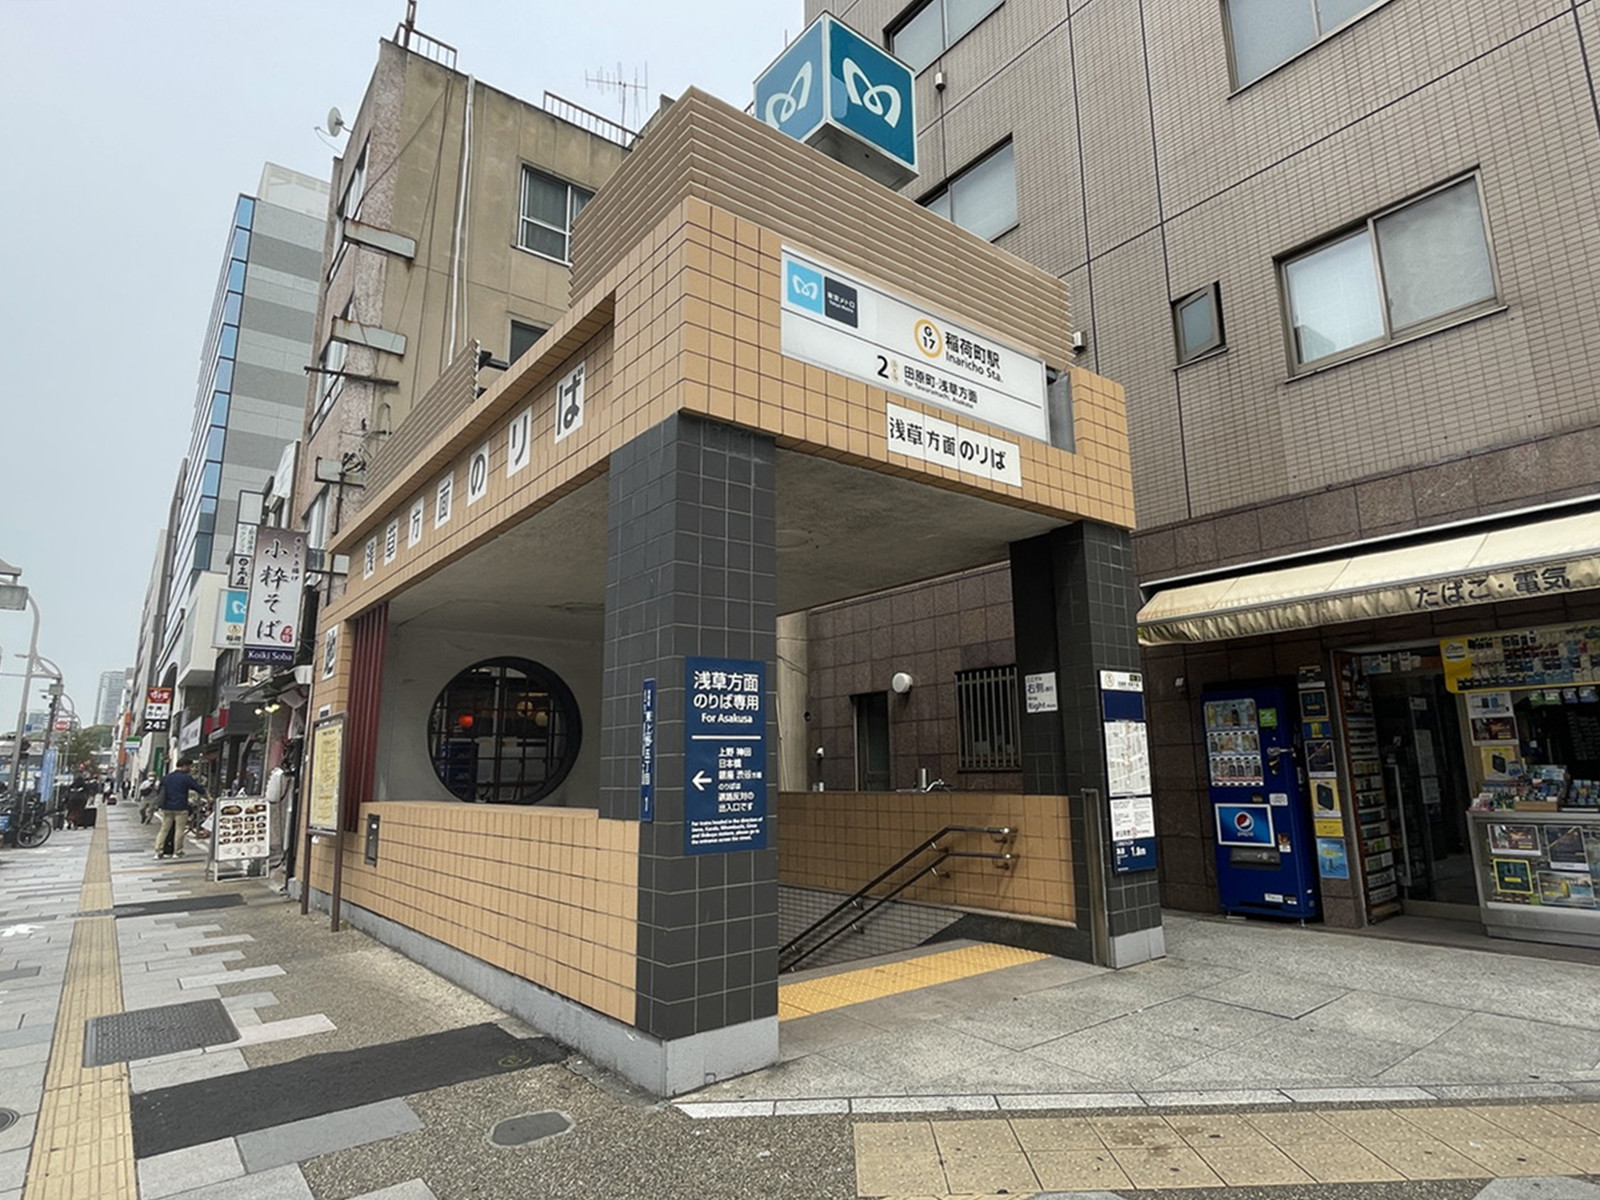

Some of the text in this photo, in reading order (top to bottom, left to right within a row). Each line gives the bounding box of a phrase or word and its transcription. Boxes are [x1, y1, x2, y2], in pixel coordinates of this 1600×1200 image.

[922, 336, 936, 350] 17
[924, 326, 933, 337] G
[945, 332, 1001, 369] 稲荷町駅
[876, 355, 889, 379] 2
[945, 351, 984, 375] Inaricho
[889, 416, 1006, 470] 浅草方面のりば
[1415, 566, 1570, 609] たばこ・電気
[693, 670, 759, 692] 浅草方面
[693, 693, 759, 711] のりば専用
[701, 712, 753, 724] For Asakusa
